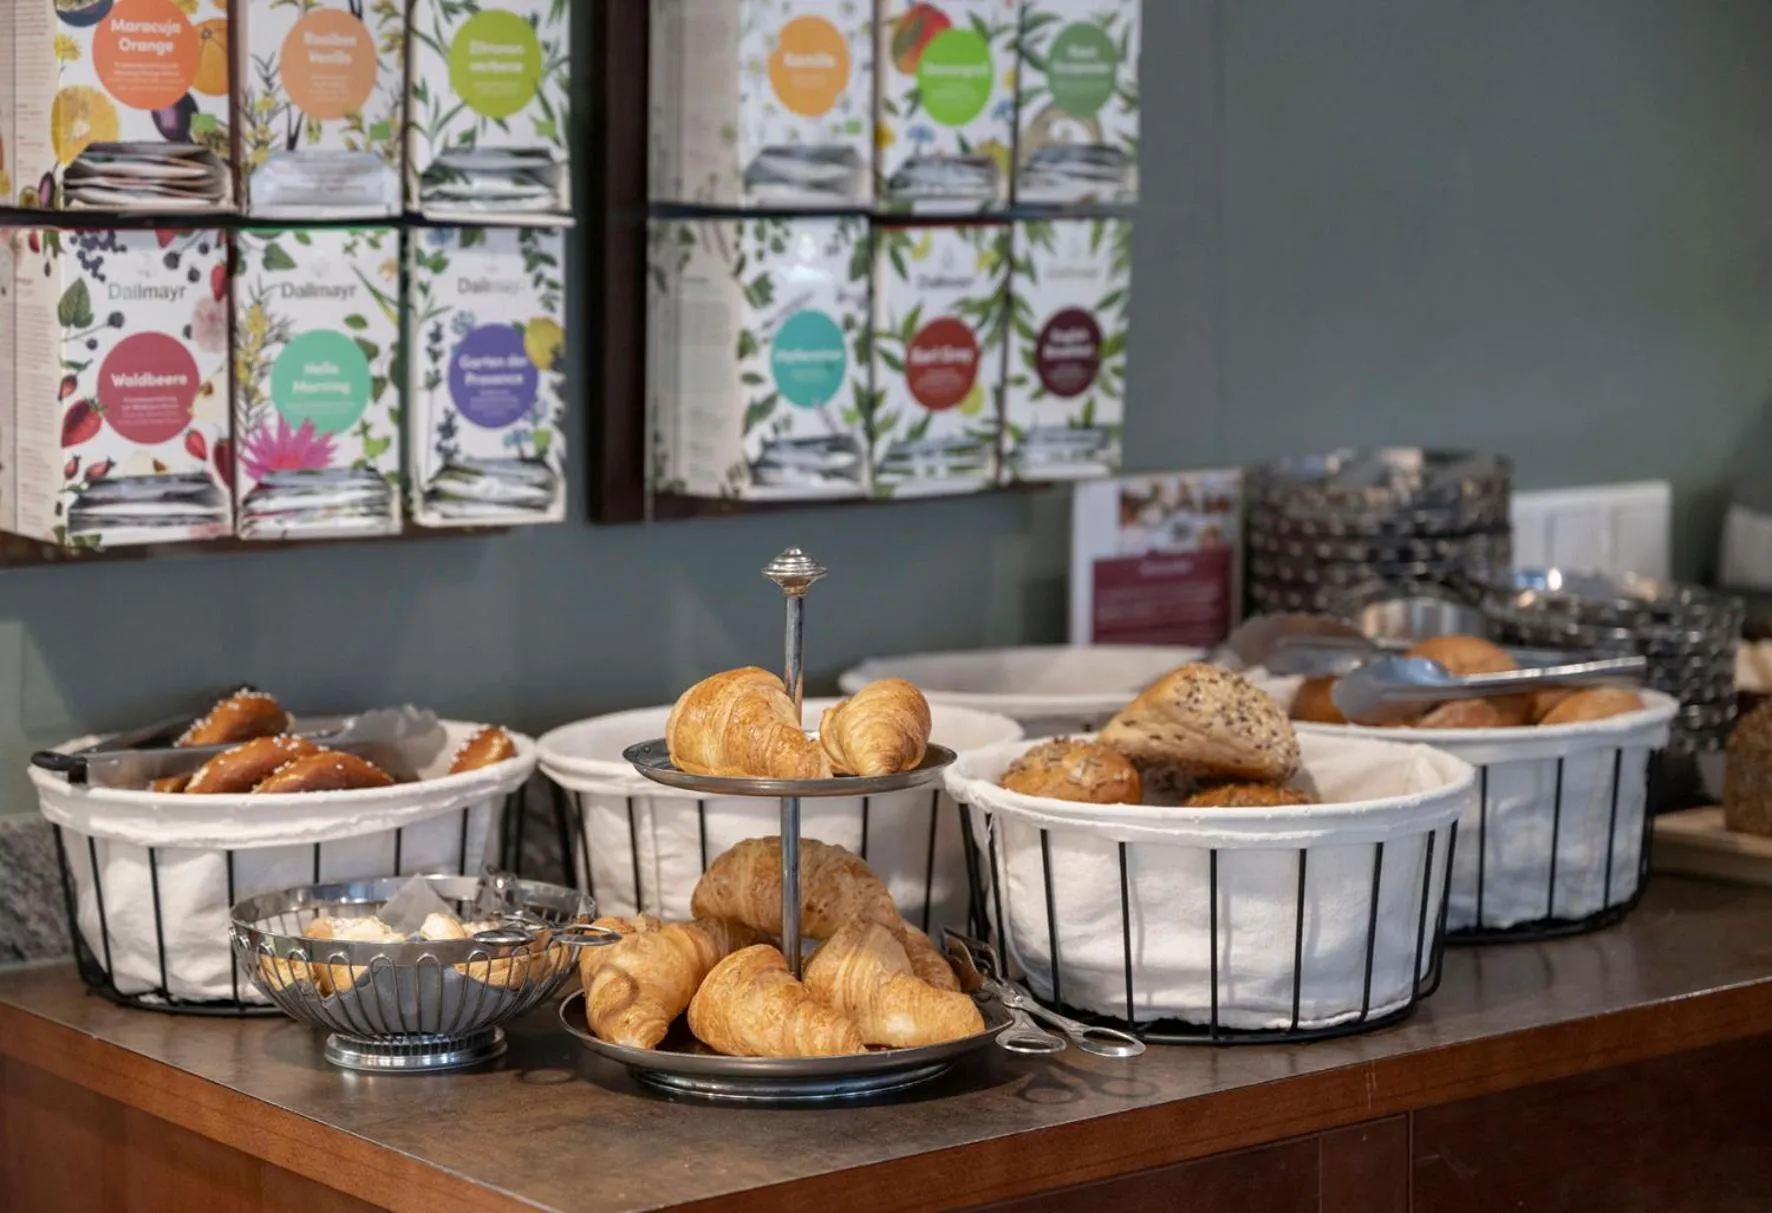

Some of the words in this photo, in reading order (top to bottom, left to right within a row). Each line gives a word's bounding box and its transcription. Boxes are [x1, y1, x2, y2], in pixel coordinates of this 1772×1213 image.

[110, 18, 182, 37] Maracuja
[118, 37, 175, 56] Orange
[108, 282, 187, 304] Dallmayr
[110, 371, 188, 388] Waldbeere
